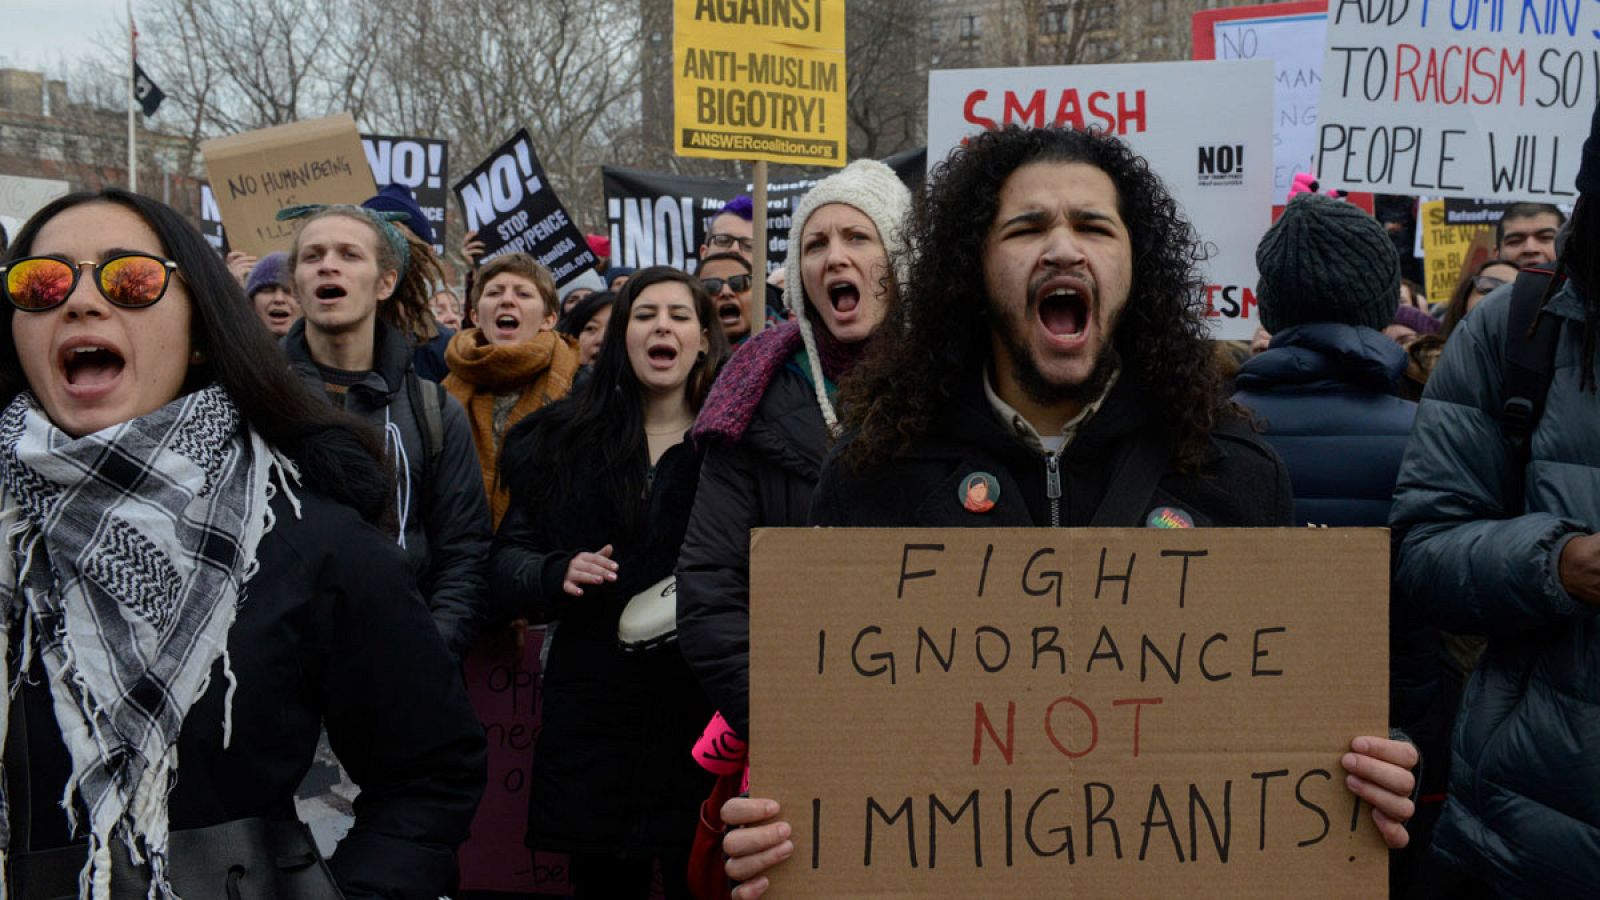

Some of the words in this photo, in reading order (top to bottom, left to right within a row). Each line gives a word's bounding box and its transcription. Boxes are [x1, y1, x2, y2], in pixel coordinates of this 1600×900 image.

[1223, 27, 1258, 60] NO
[683, 47, 838, 92] ANTI-MUSLIM
[1331, 46, 1389, 102] TO
[1393, 43, 1525, 107] RACISM
[1535, 48, 1584, 109] SO
[697, 86, 826, 134] BIGOTRY!
[963, 87, 1147, 136] SMASH
[361, 139, 443, 190] NO!
[690, 131, 833, 157] ANSWERcoalition.org
[1198, 145, 1244, 174] NO!
[1317, 123, 1467, 191] PEOPLE
[1489, 131, 1575, 197] WILL
[227, 173, 258, 200] NO
[261, 162, 312, 195] HUMAN
[311, 154, 352, 182] BEING
[460, 138, 542, 233] NO!
[496, 209, 529, 241] STOP
[898, 543, 1208, 609] FIGHT
[817, 625, 1286, 685] IGNORANCE
[972, 695, 1163, 766] NOT
[811, 768, 1361, 870] IMMIGRANTS!
